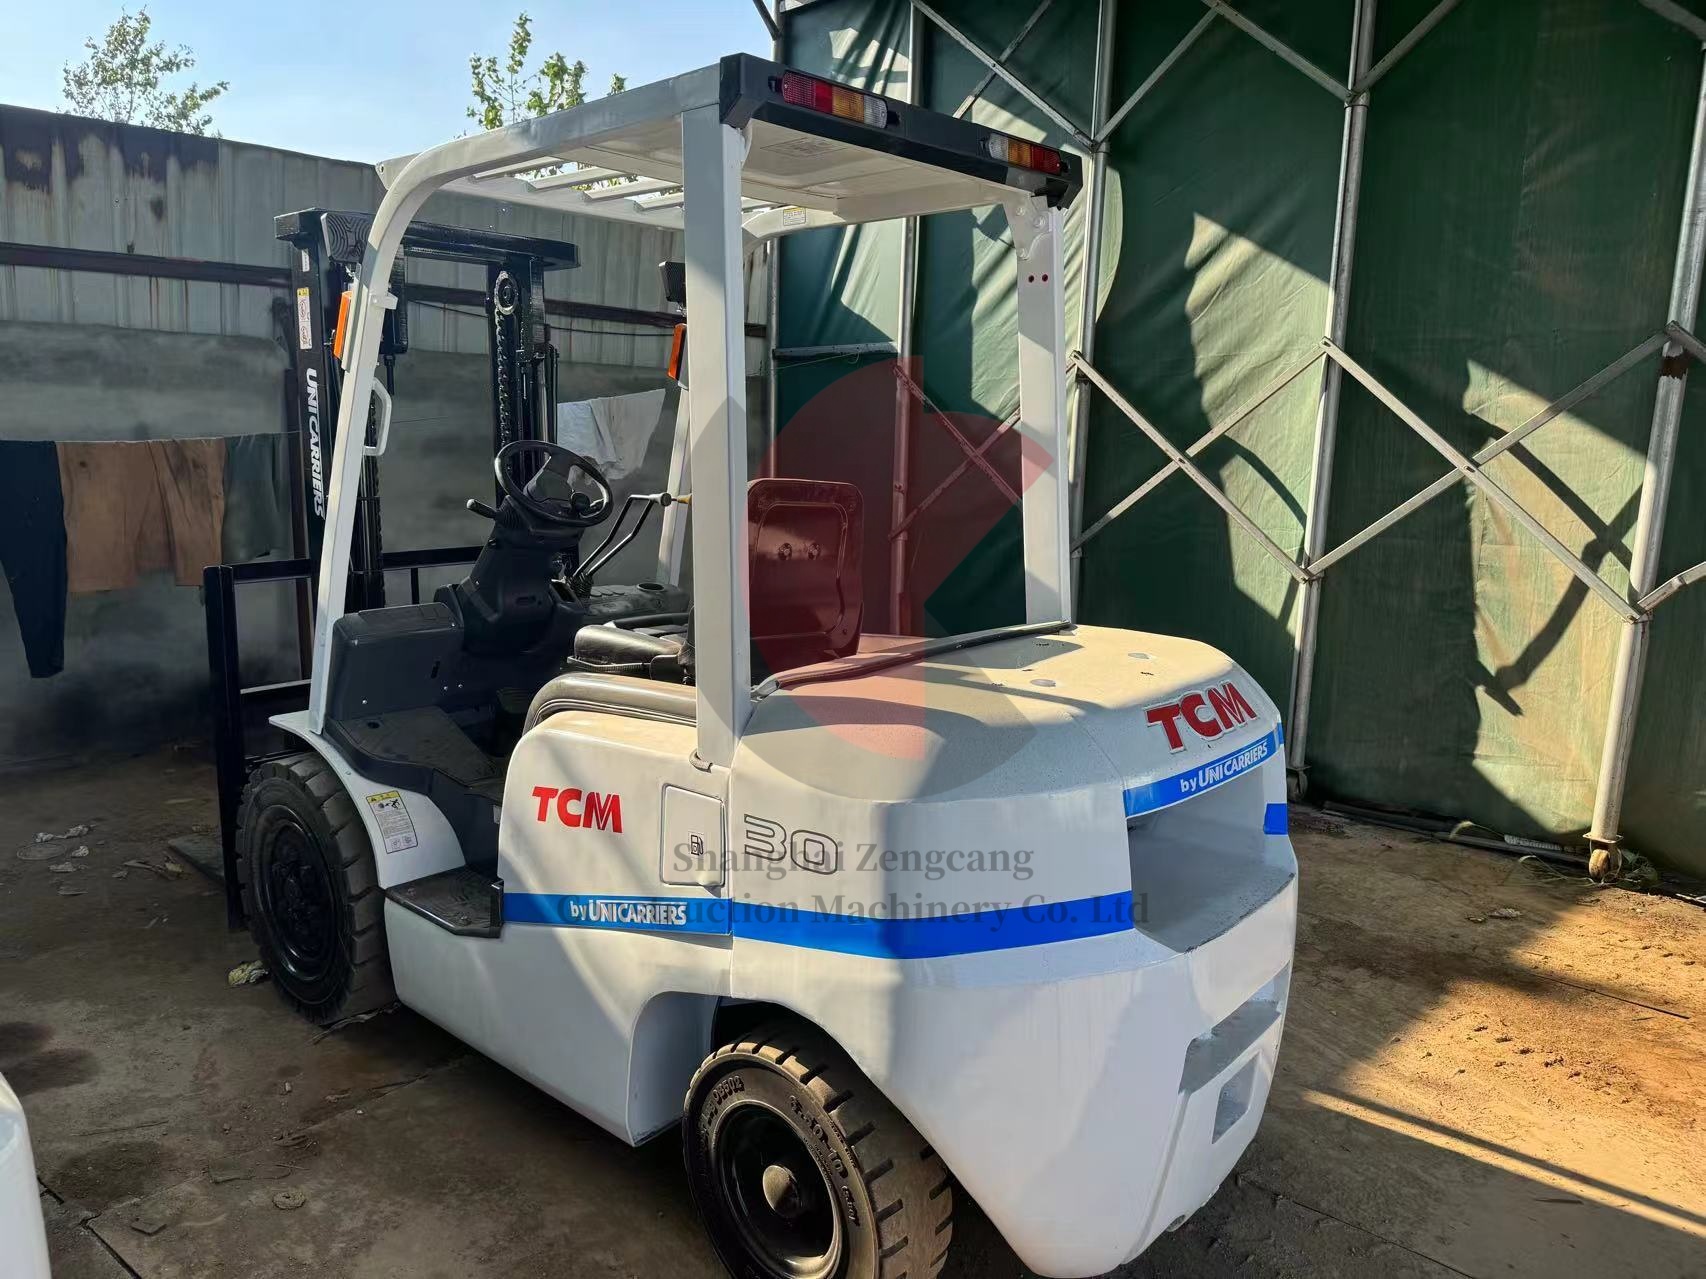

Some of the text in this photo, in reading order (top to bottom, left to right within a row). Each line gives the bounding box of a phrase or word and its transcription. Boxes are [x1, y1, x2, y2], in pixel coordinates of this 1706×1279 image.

[306, 367, 325, 520] UNICARRIERS
[1145, 681, 1258, 751] TCM
[1180, 738, 1268, 793] by UNICARRIERS
[532, 786, 623, 833] TCM
[744, 813, 838, 875] 30
[570, 899, 688, 925] by UNICARRIERS
